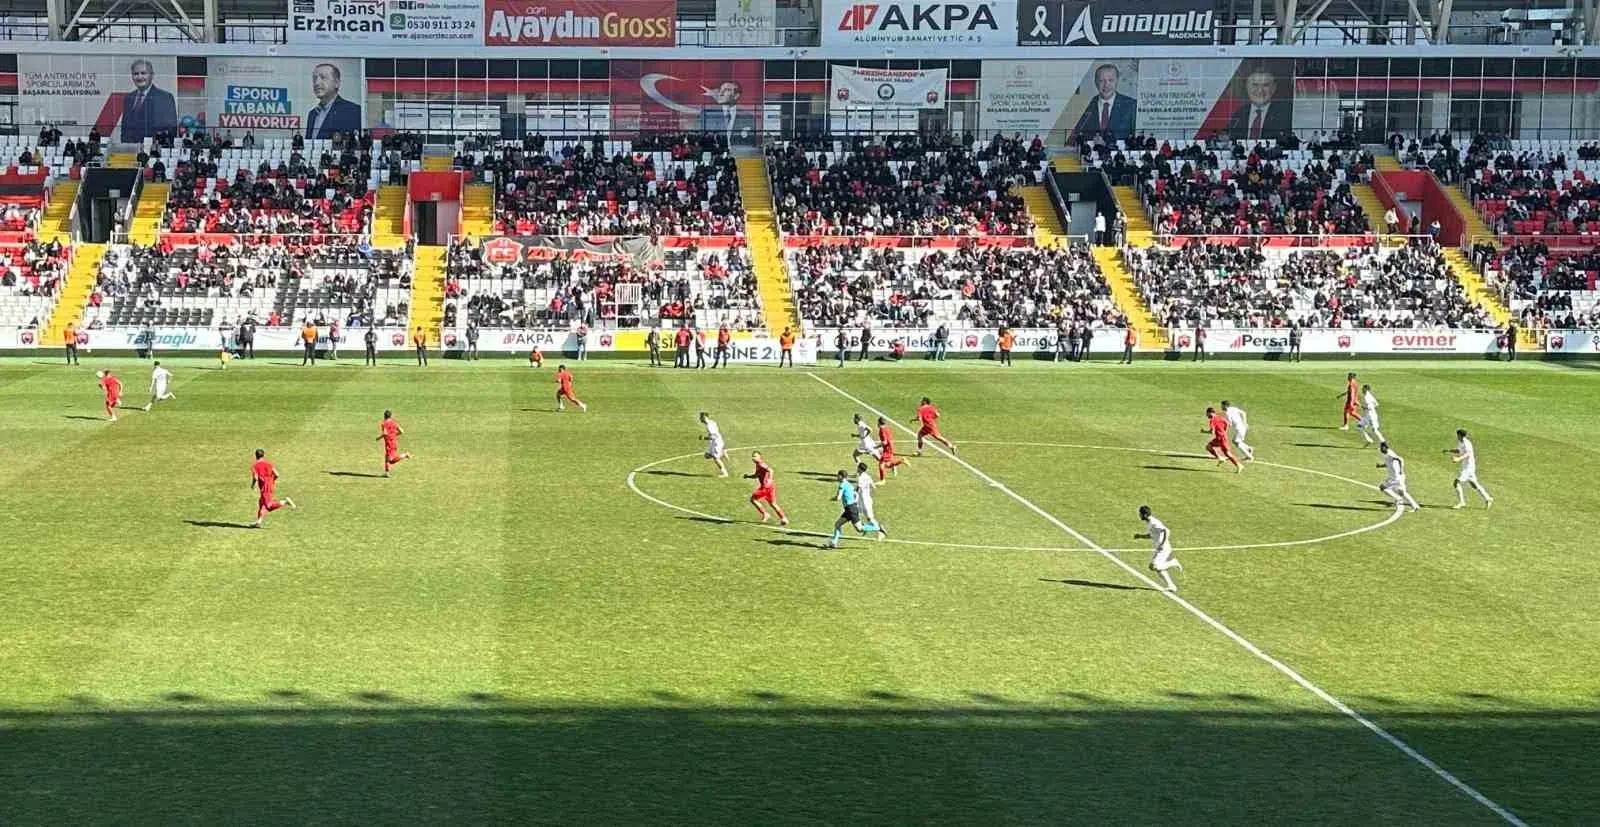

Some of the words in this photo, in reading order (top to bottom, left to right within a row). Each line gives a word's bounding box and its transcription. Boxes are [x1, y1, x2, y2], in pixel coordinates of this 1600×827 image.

[333, 2, 375, 16] ajans
[293, 15, 385, 32] Erzincan
[878, 4, 999, 31] AKPA
[1101, 10, 1213, 35] anagold
[407, 21, 430, 30] 0530
[432, 21, 449, 30] 911
[451, 21, 463, 30] 33
[464, 21, 476, 30] 24
[488, 10, 600, 42] Ayaydın
[603, 12, 667, 39] Gross
[233, 87, 280, 100] SPORU
[229, 101, 286, 114] TABANA
[221, 115, 298, 129] YAYIYORUZ
[516, 333, 554, 345] AKPA
[1243, 335, 1288, 347] Persa
[1392, 335, 1457, 346] evmer
